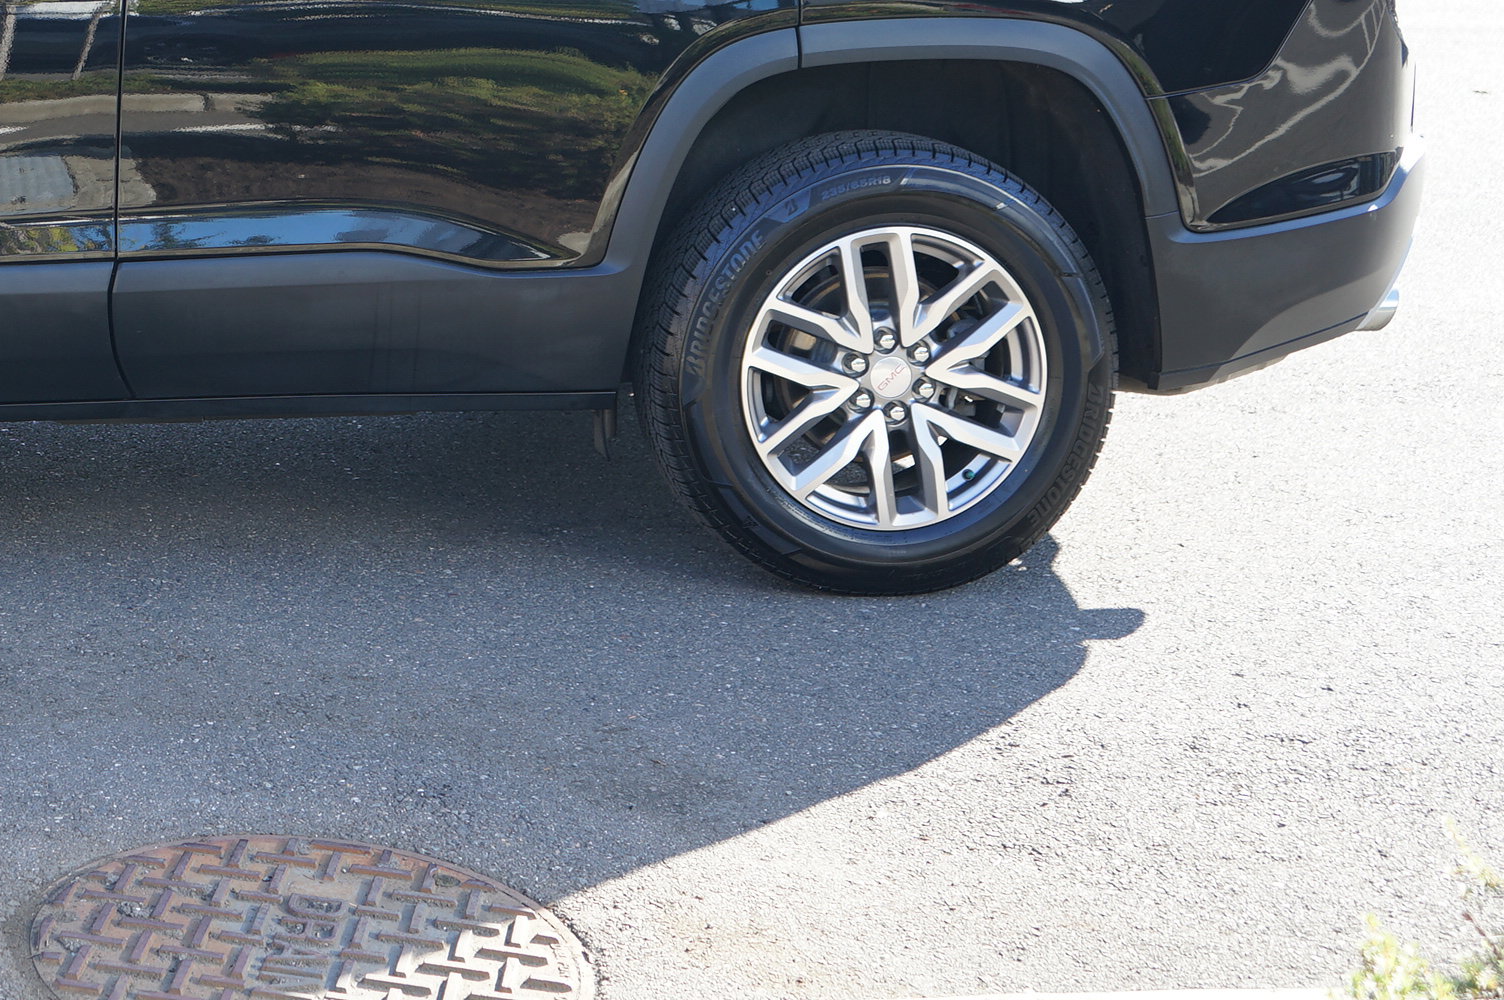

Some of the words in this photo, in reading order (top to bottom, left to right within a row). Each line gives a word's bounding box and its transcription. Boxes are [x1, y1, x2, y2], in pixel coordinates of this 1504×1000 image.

[686, 229, 768, 378] BRIDGESTONE
[877, 363, 906, 391] GMC
[1027, 384, 1104, 528] BRIDGESTONE
[253, 893, 344, 999] DRAIN
